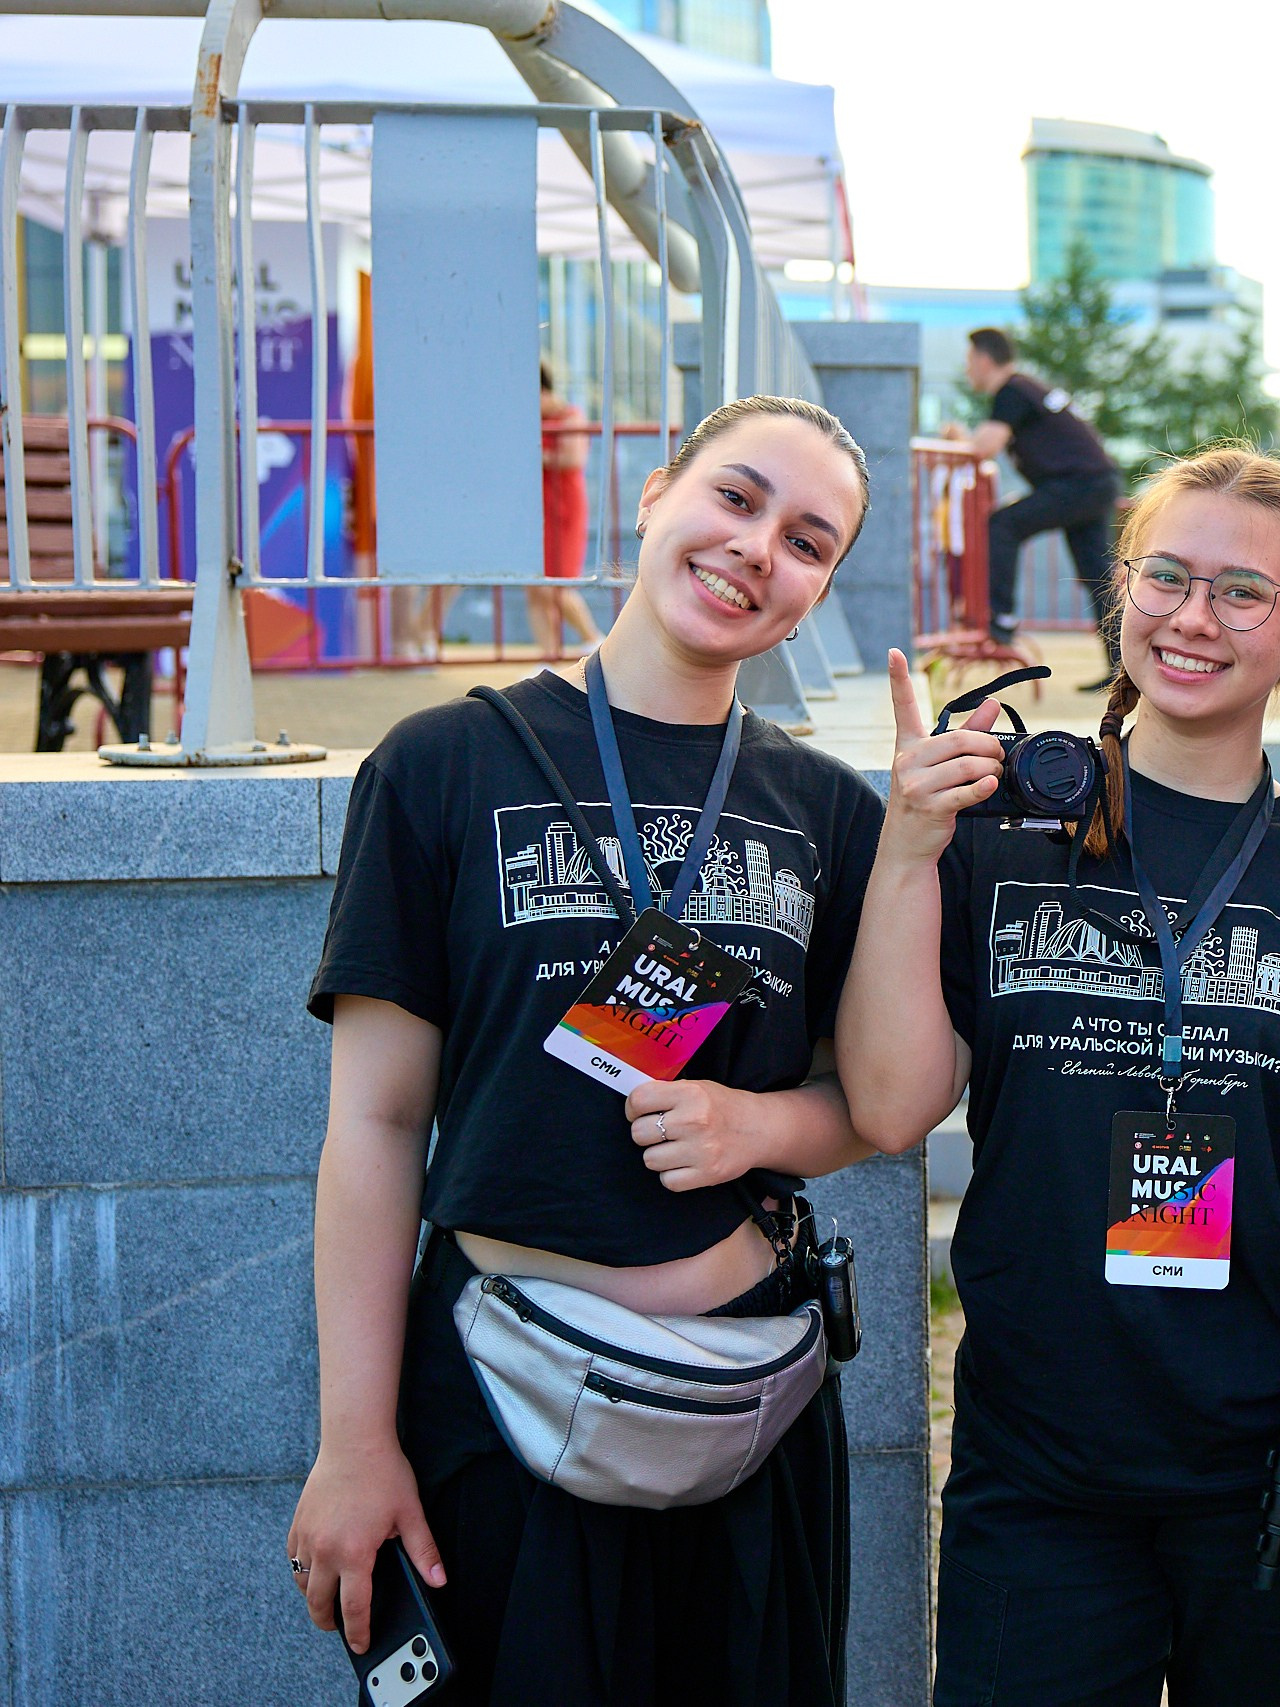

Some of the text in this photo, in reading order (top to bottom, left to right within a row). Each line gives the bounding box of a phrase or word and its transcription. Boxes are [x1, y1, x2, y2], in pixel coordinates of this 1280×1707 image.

[174, 262, 278, 291] UL
[716, 944, 761, 961] ЛАЛ
[535, 961, 575, 981] ДЛЯ
[634, 953, 698, 1002] URAL
[616, 974, 699, 1031] MUSIC
[600, 994, 684, 1049] NIGHT
[1071, 1016, 1229, 1042] А ЧТО ТЫ СЕЛАЛ
[1012, 1034, 1044, 1051] ДЛЯ
[1048, 1035, 1154, 1056] УРАЛЬСКОЙ
[1157, 1043, 1204, 1061] НЧИ
[590, 1056, 622, 1078] СМИ
[1117, 1064, 1174, 1082] Львов
[1133, 1154, 1202, 1176] URAL
[1131, 1179, 1217, 1203] MUSIC
[1130, 1203, 1215, 1226] NIGHT
[1152, 1265, 1184, 1277] СМИ
